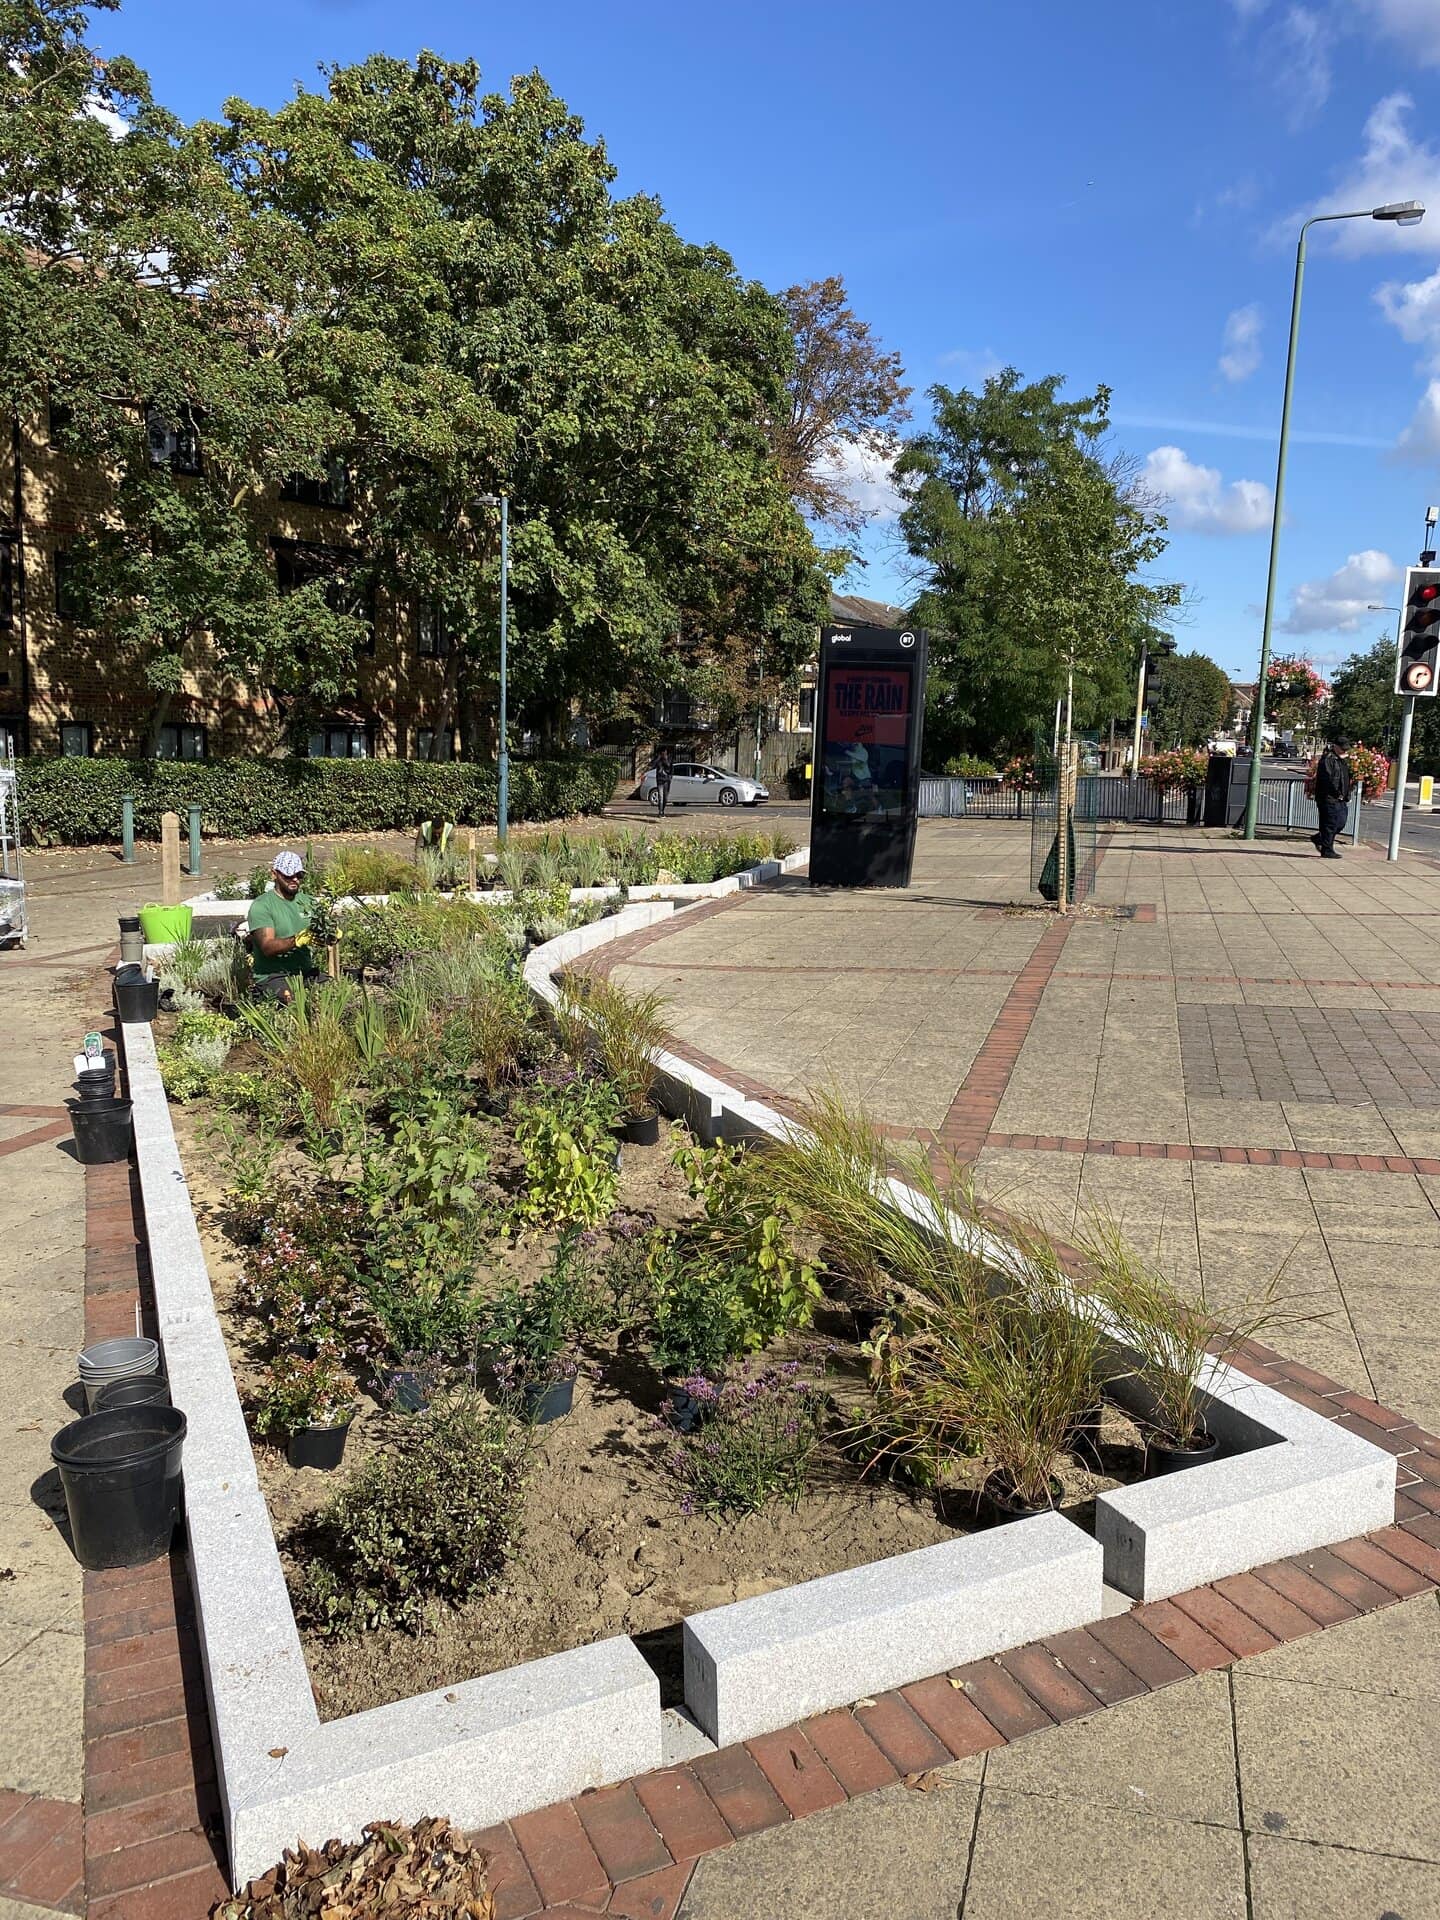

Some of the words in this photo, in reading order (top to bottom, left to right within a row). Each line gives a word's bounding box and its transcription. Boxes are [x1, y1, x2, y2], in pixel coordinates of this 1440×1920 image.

[831, 634, 852, 643] global
[835, 682, 861, 709] THE
[865, 684, 903, 711] RAIN
